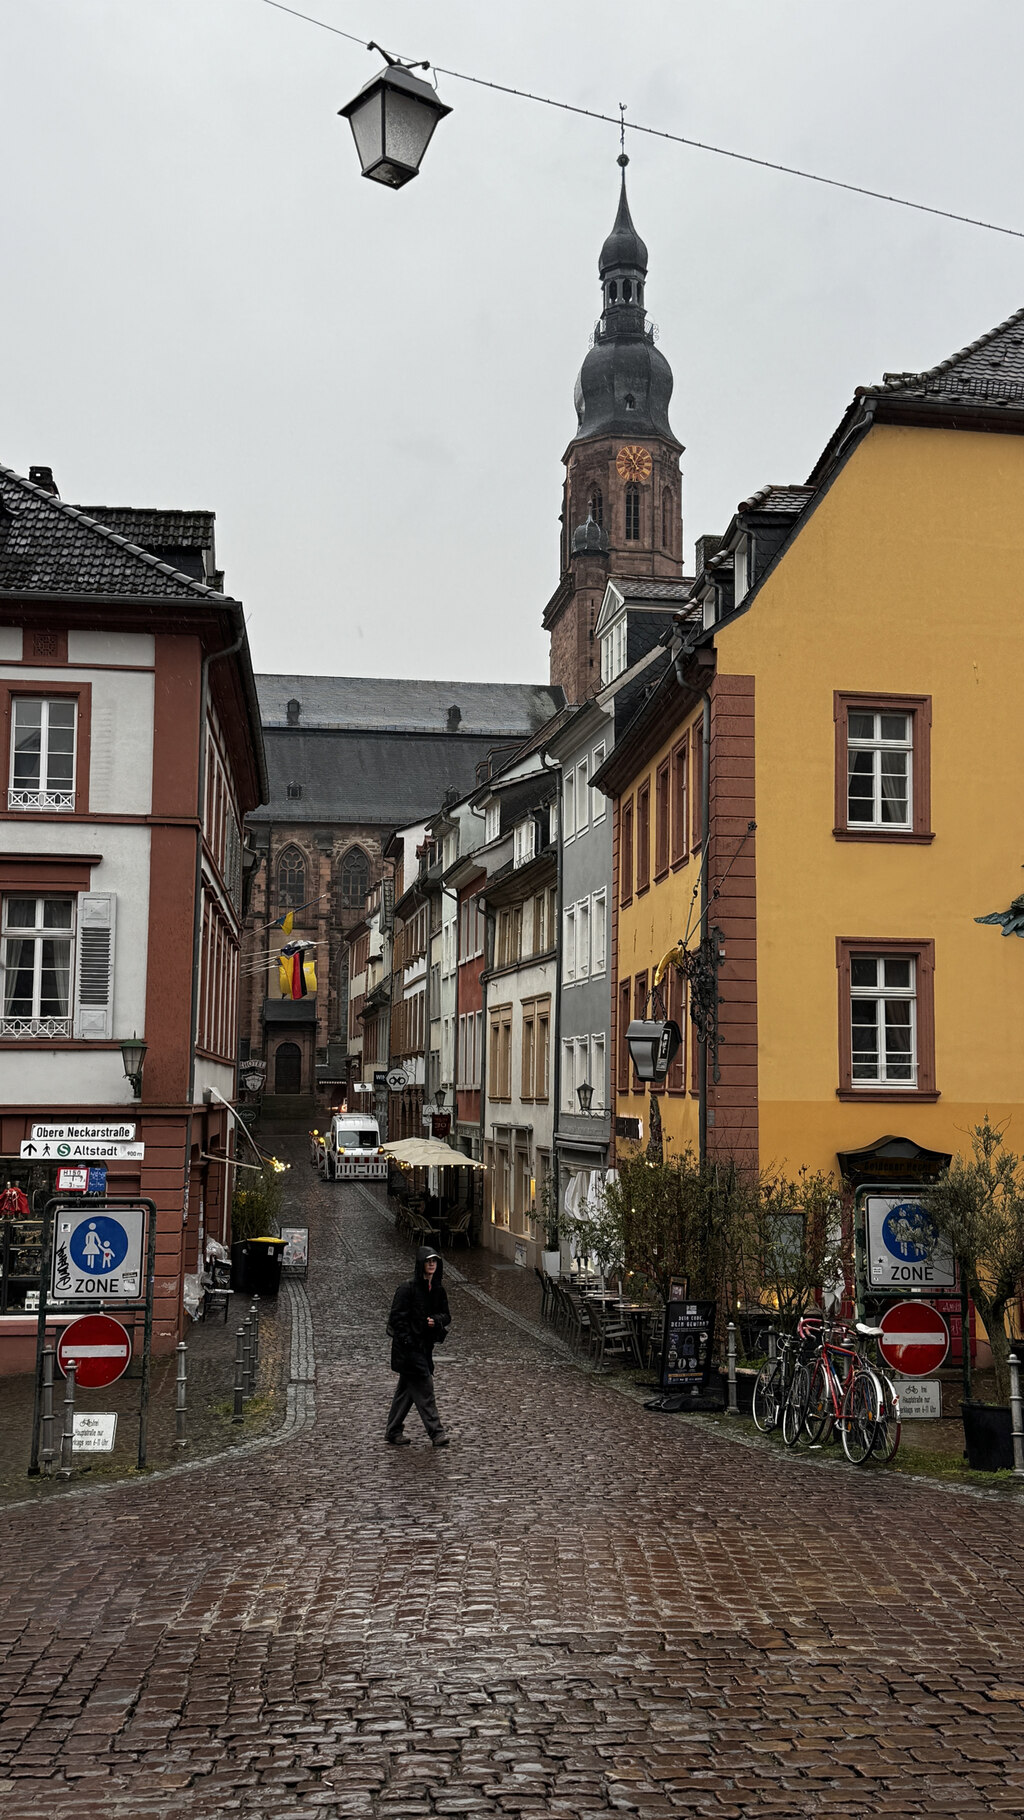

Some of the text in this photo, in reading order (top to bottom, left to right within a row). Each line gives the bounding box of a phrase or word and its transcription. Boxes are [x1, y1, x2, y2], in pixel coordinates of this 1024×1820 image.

[36, 1126, 130, 1138] Obere Neckarstraße
[73, 1145, 118, 1156] Altstadt
[891, 1266, 934, 1280] ZONE
[74, 1278, 119, 1293] ZONE
